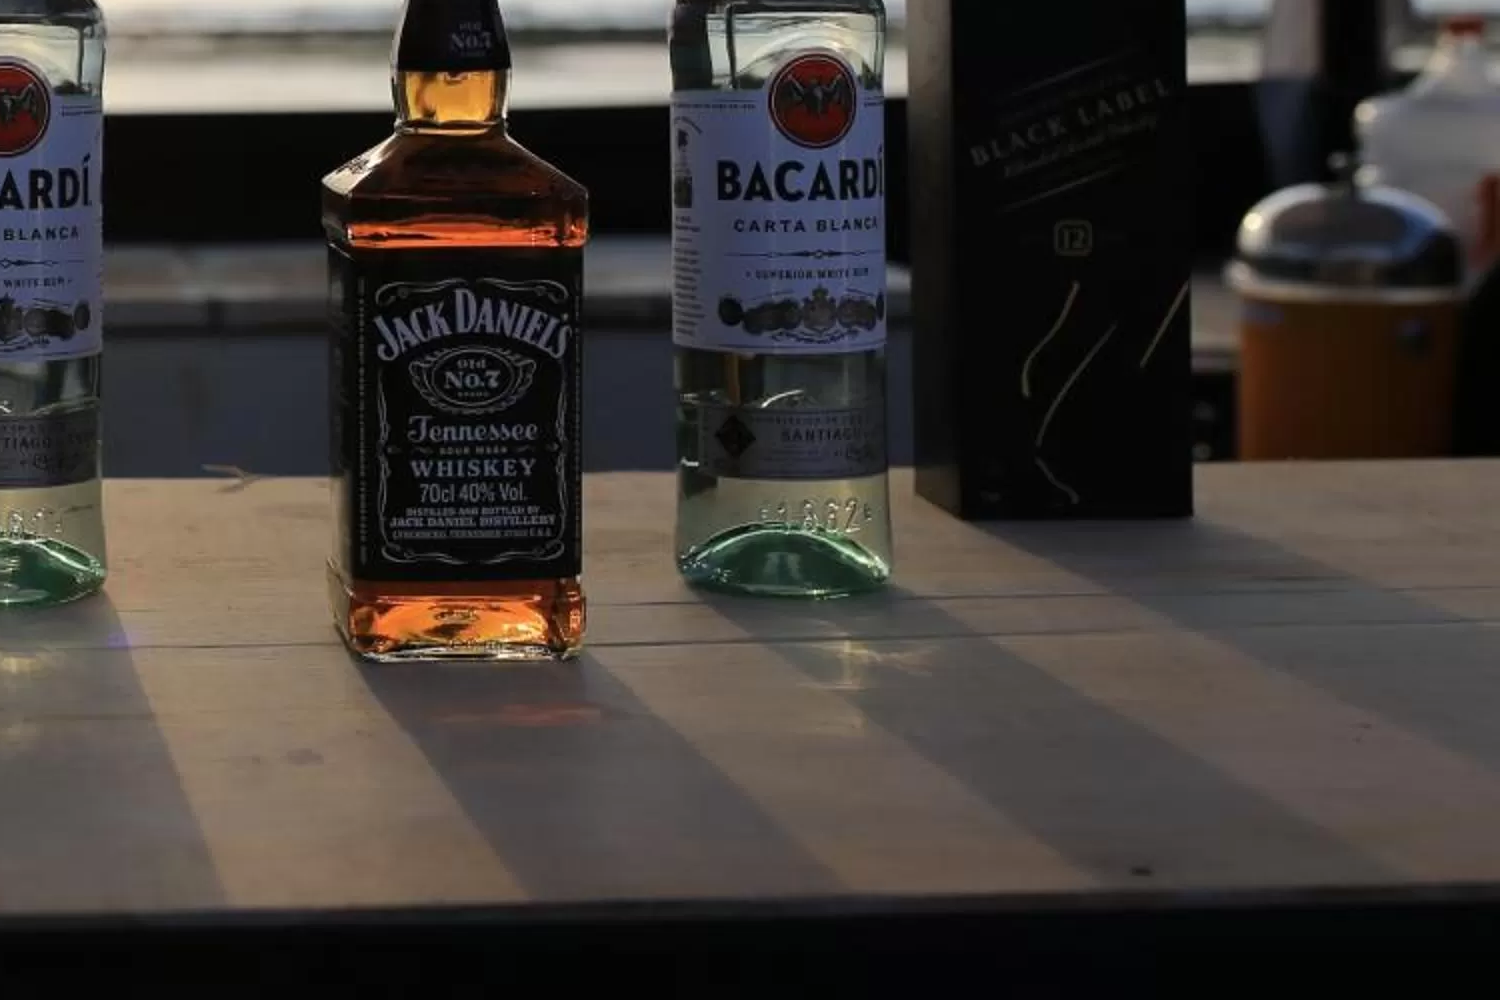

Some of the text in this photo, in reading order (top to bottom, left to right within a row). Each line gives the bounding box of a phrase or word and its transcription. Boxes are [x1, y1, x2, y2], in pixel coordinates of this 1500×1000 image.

[970, 117, 1068, 167] BLACK
[1077, 78, 1169, 126] LABEL
[3, 226, 79, 240] BLANCA
[733, 216, 877, 233] CARTA BLANCA
[372, 288, 572, 361] JACK DANIEL'S
[407, 415, 538, 443] Tennessee
[409, 458, 537, 478] WHISKEY
[419, 482, 455, 502] 70cl
[458, 481, 496, 502] 40%
